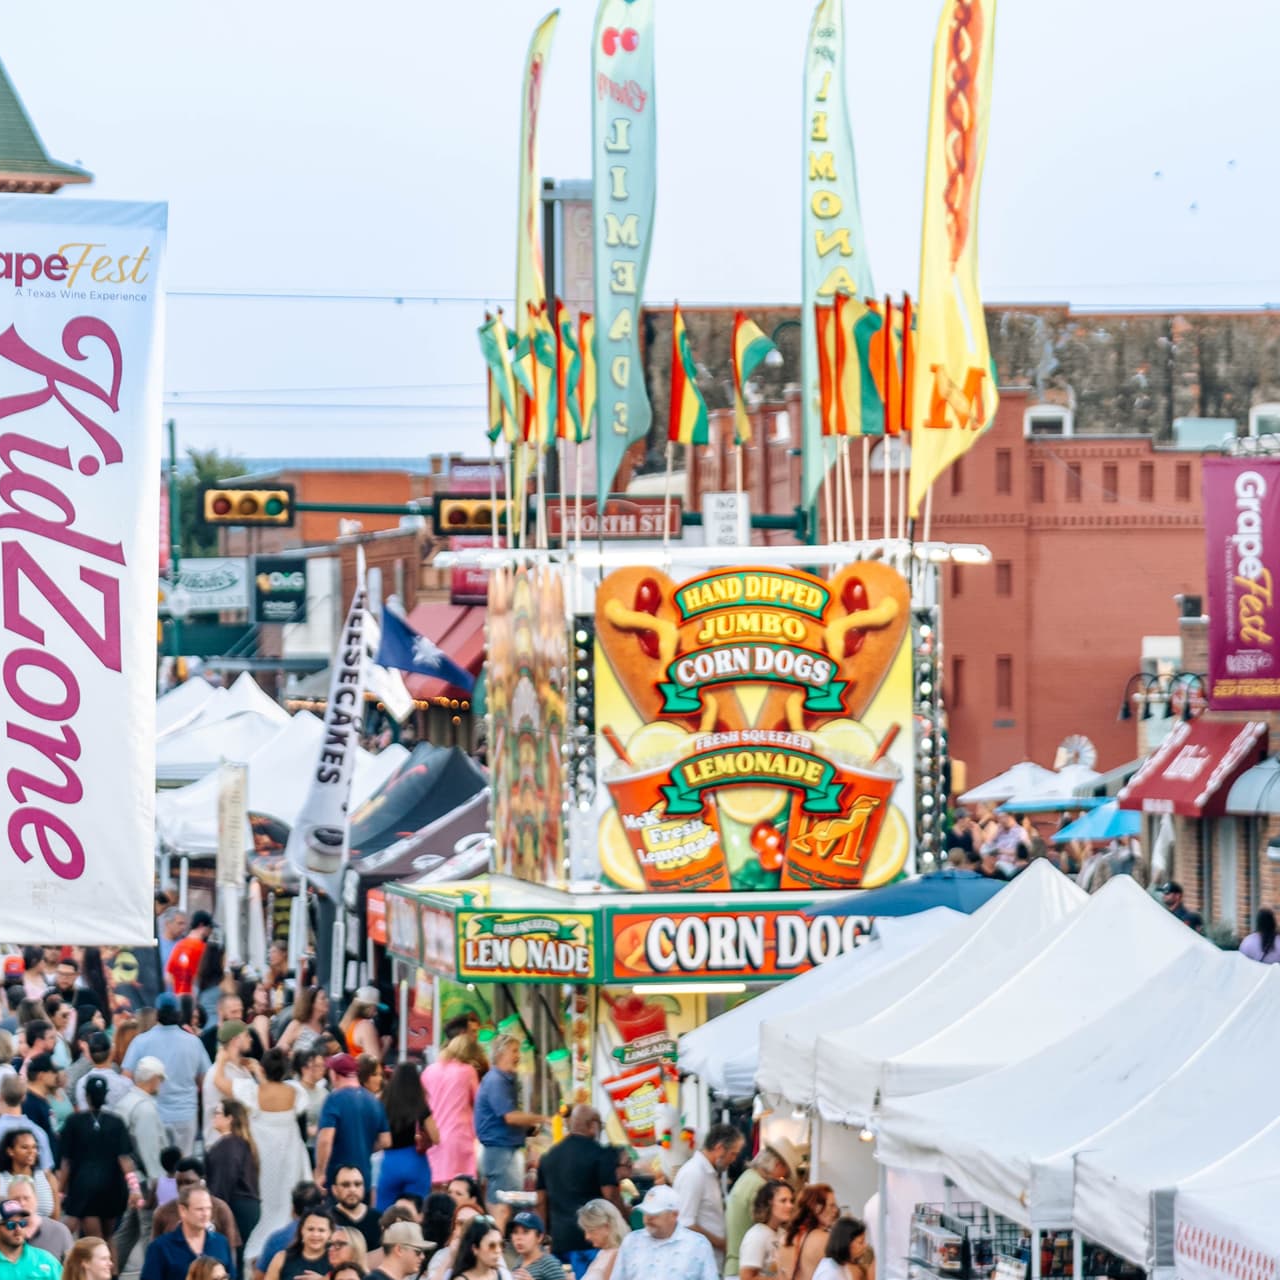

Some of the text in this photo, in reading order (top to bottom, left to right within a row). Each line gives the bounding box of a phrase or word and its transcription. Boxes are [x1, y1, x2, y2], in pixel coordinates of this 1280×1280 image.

[15, 288, 148, 302] A Texas Wine Experience
[1232, 470, 1273, 646] GrapeFest
[683, 575, 824, 612] HAND DIPPED
[698, 612, 807, 643] JUMBO
[676, 647, 831, 684] CORN DOGS
[696, 729, 812, 751] FRESH SQUEEZED
[683, 751, 824, 785] LEMONADE
[648, 818, 705, 845] Fresh
[464, 935, 590, 975] LEMONADE
[646, 914, 875, 971] CORN DOG
[623, 1041, 674, 1062] LIMEADE
